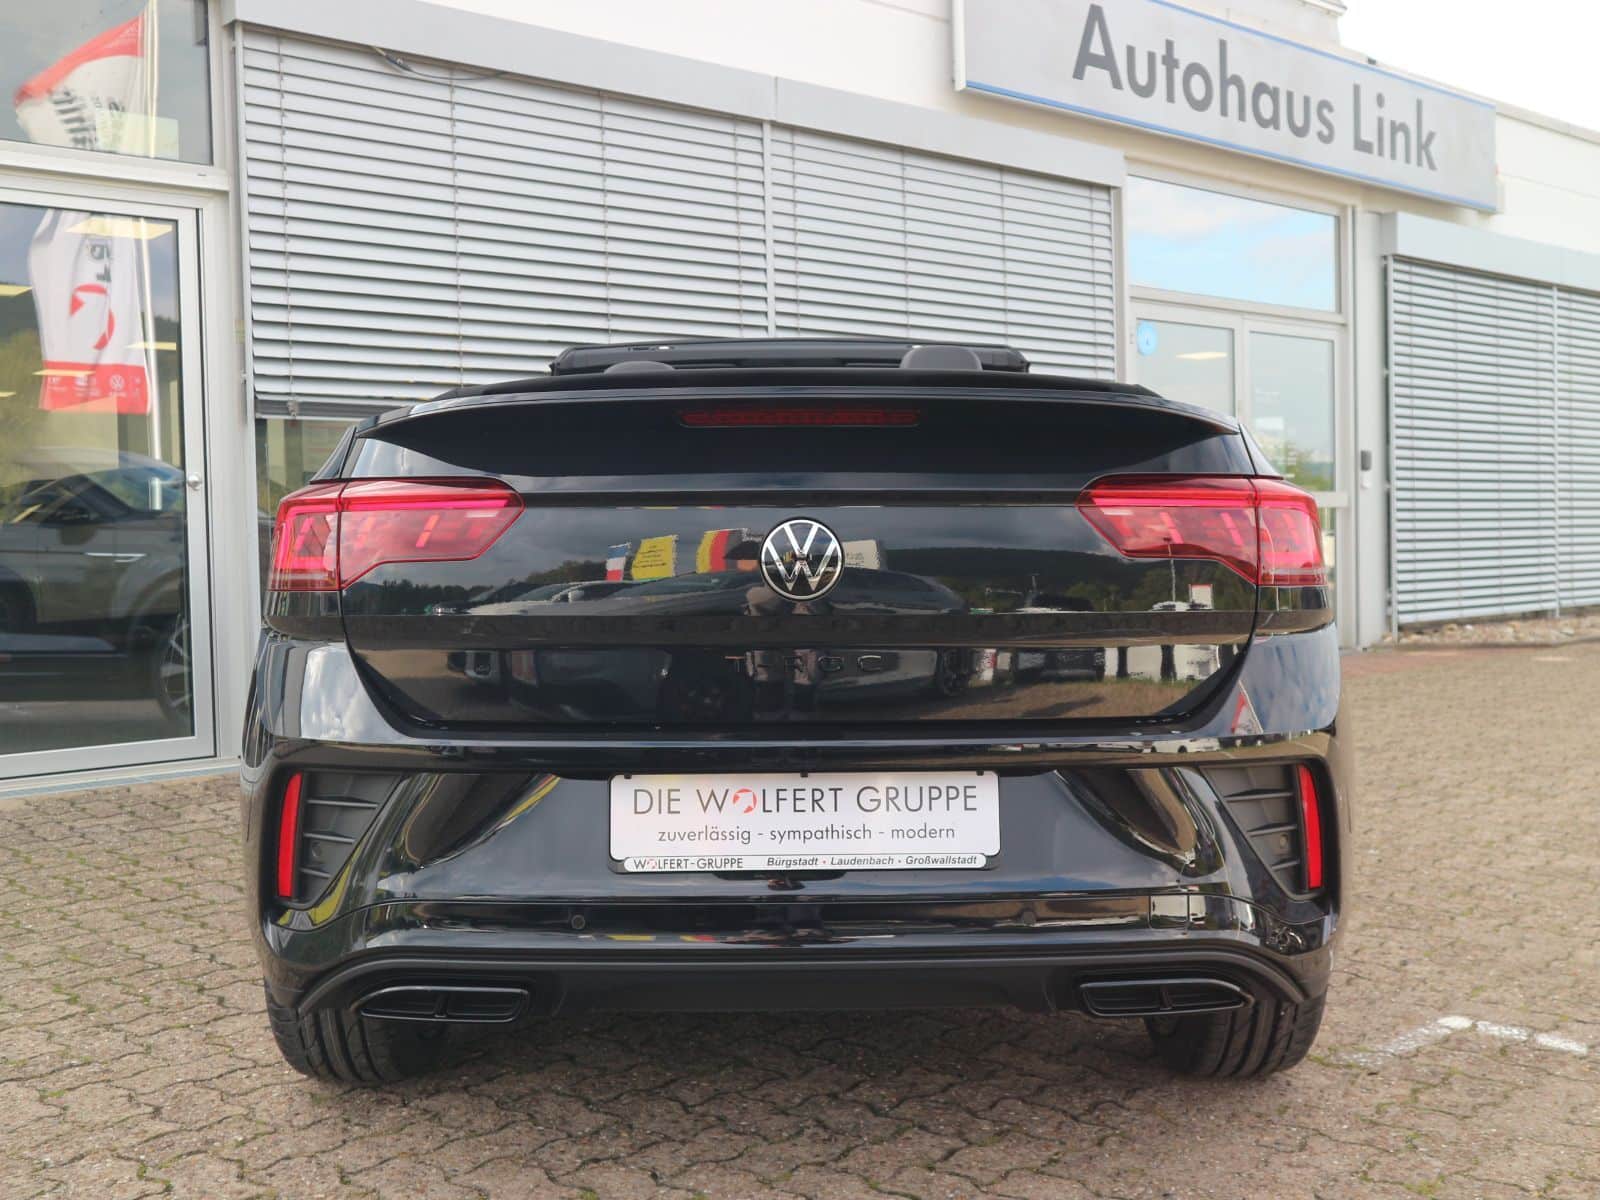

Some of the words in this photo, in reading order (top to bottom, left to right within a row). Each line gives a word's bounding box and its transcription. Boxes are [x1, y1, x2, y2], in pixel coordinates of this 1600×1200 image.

[1072, 3, 1335, 145] Autohaus
[1352, 83, 1438, 171] Link
[634, 788, 681, 815] DIE
[856, 785, 977, 813] GRUPPE
[658, 825, 751, 844] zuverlässig
[770, 824, 872, 845] sympathisch
[891, 823, 955, 839] modern
[767, 857, 818, 867] Bürgstadt
[830, 856, 894, 866] Laudenbach
[905, 855, 977, 866] Großwallstadt
